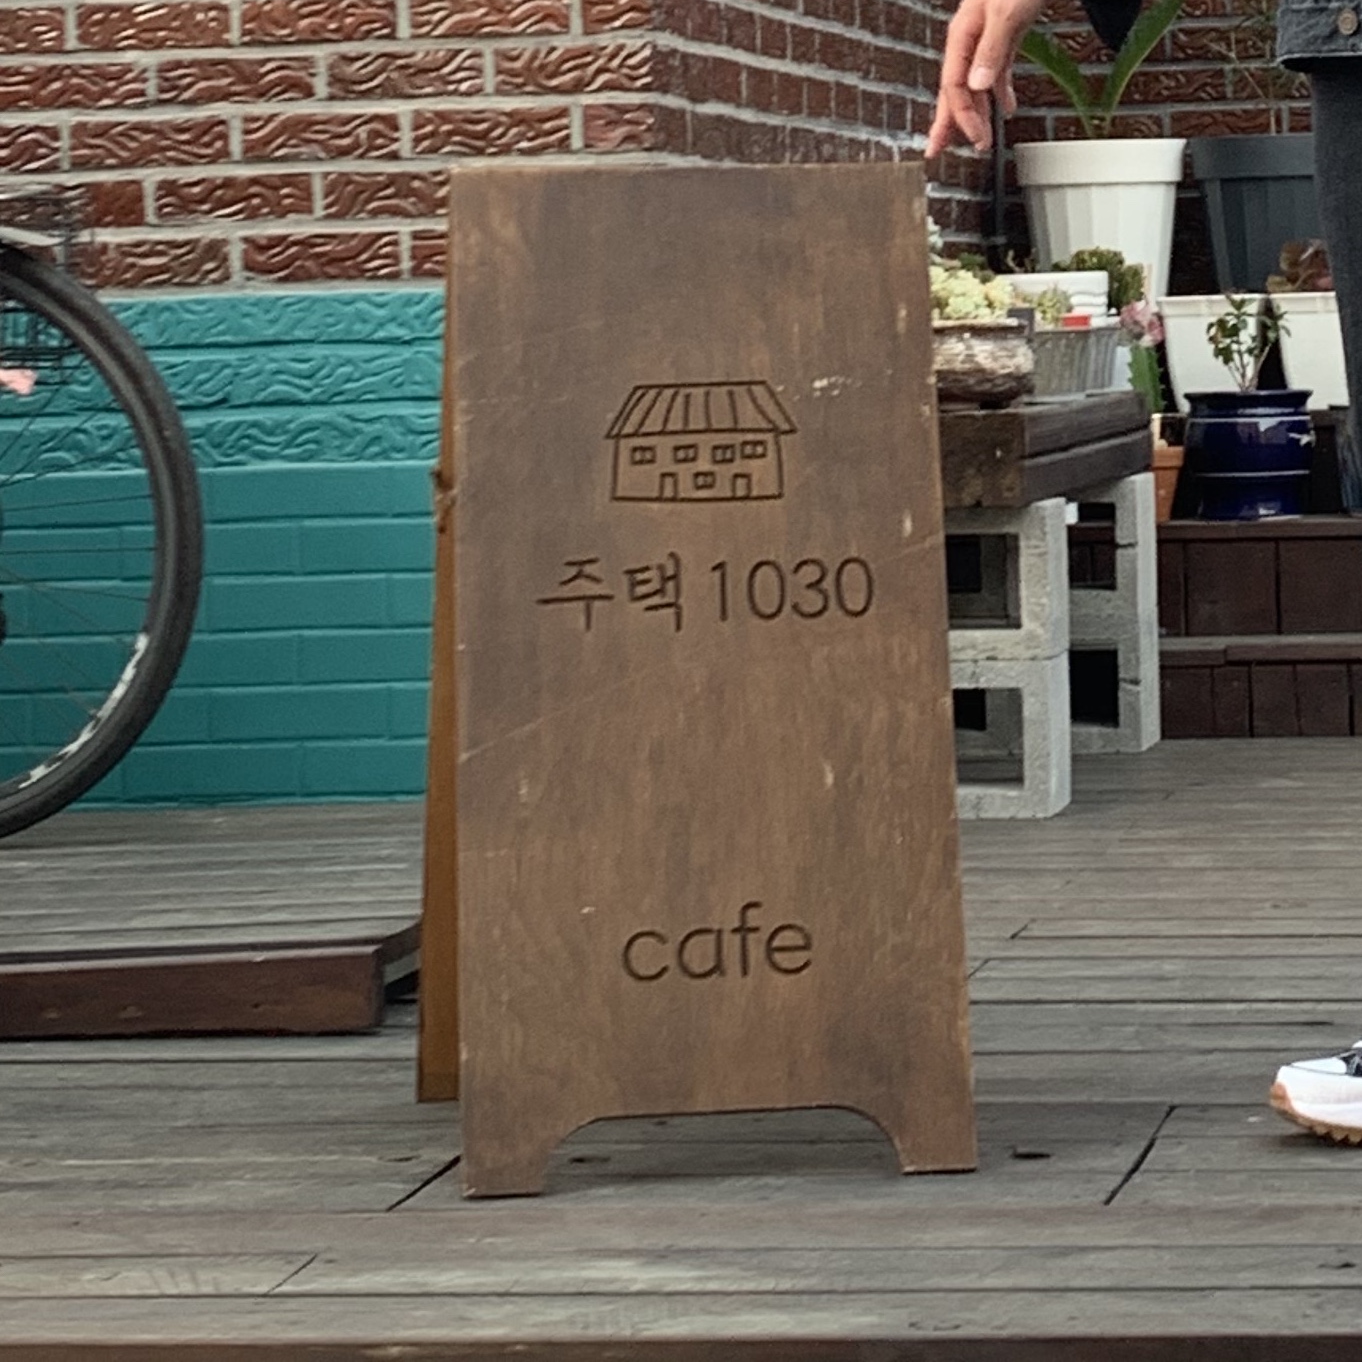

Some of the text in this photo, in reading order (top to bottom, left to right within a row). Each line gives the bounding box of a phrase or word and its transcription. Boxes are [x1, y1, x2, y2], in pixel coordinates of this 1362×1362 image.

[535, 551, 874, 632] 주택 1030
[622, 901, 812, 981] cafe
